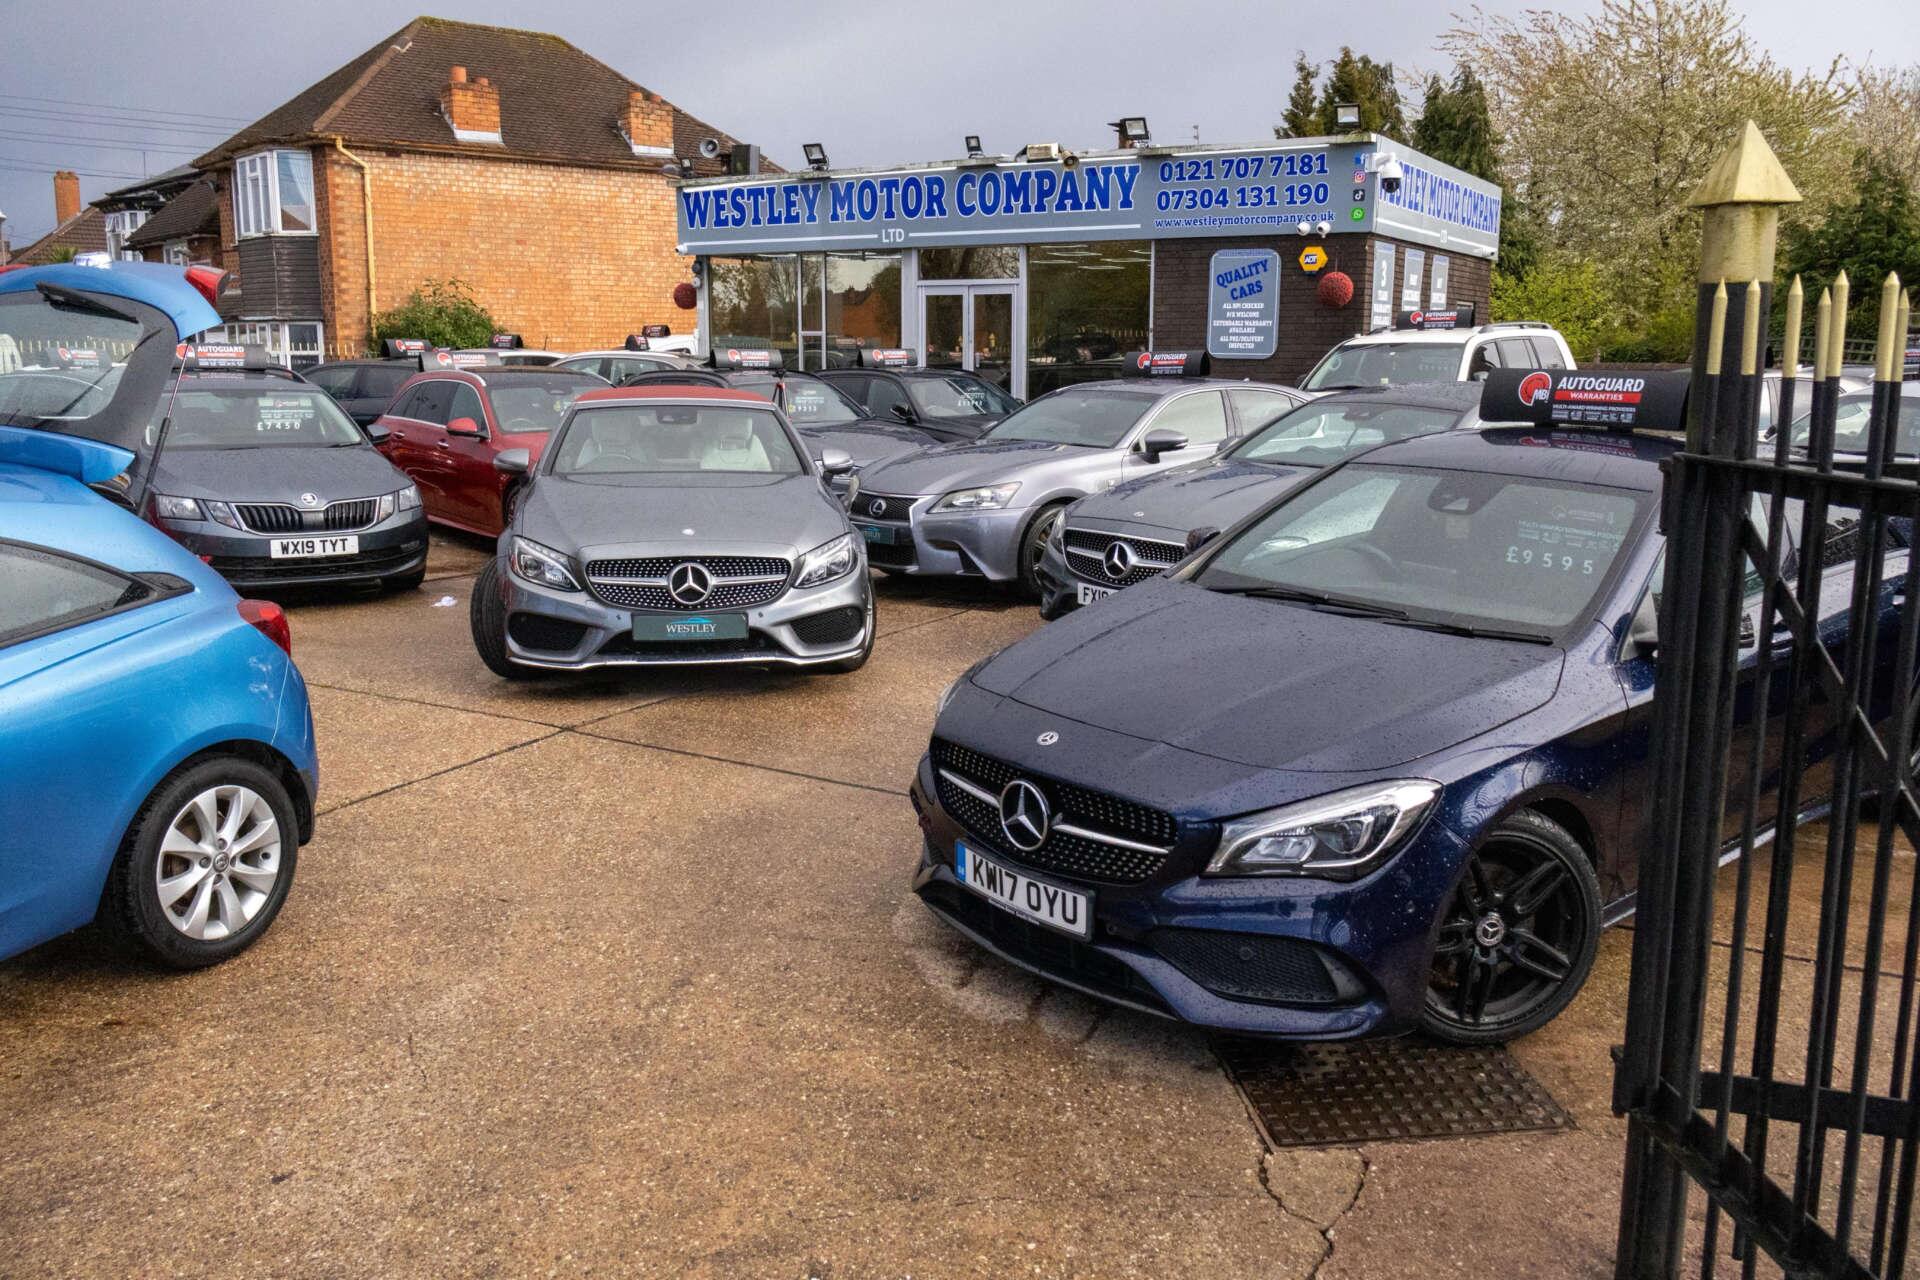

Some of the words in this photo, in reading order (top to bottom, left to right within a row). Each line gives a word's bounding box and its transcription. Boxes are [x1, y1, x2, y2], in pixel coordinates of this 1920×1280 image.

[1160, 160, 1216, 183] 0121
[1221, 157, 1264, 179] 707
[1269, 153, 1329, 177] 7181
[683, 183, 822, 230] WESTLEY
[829, 175, 948, 223] MOTOR
[955, 163, 1141, 218] COMPANY
[1157, 187, 1229, 211] 07304
[1236, 185, 1278, 208] 131
[1284, 182, 1330, 206] 190
[1428, 174, 1460, 224] MOTOR
[1460, 187, 1500, 235] COMPANY
[1155, 210, 1336, 228] www.westleymotorcompany.co.uk
[882, 228, 905, 243] LTD
[1304, 255, 1317, 264] ADT
[1216, 259, 1269, 288] QUALITY
[1230, 280, 1264, 301] CARS
[1557, 376, 1645, 392] AUTOGUARD
[1570, 391, 1624, 401] WARRANTIES
[281, 540, 315, 555] WX19
[320, 538, 348, 553] TYT
[666, 624, 717, 633] WESTLEY
[972, 854, 1018, 901] KW17
[1026, 881, 1078, 925] OYU
